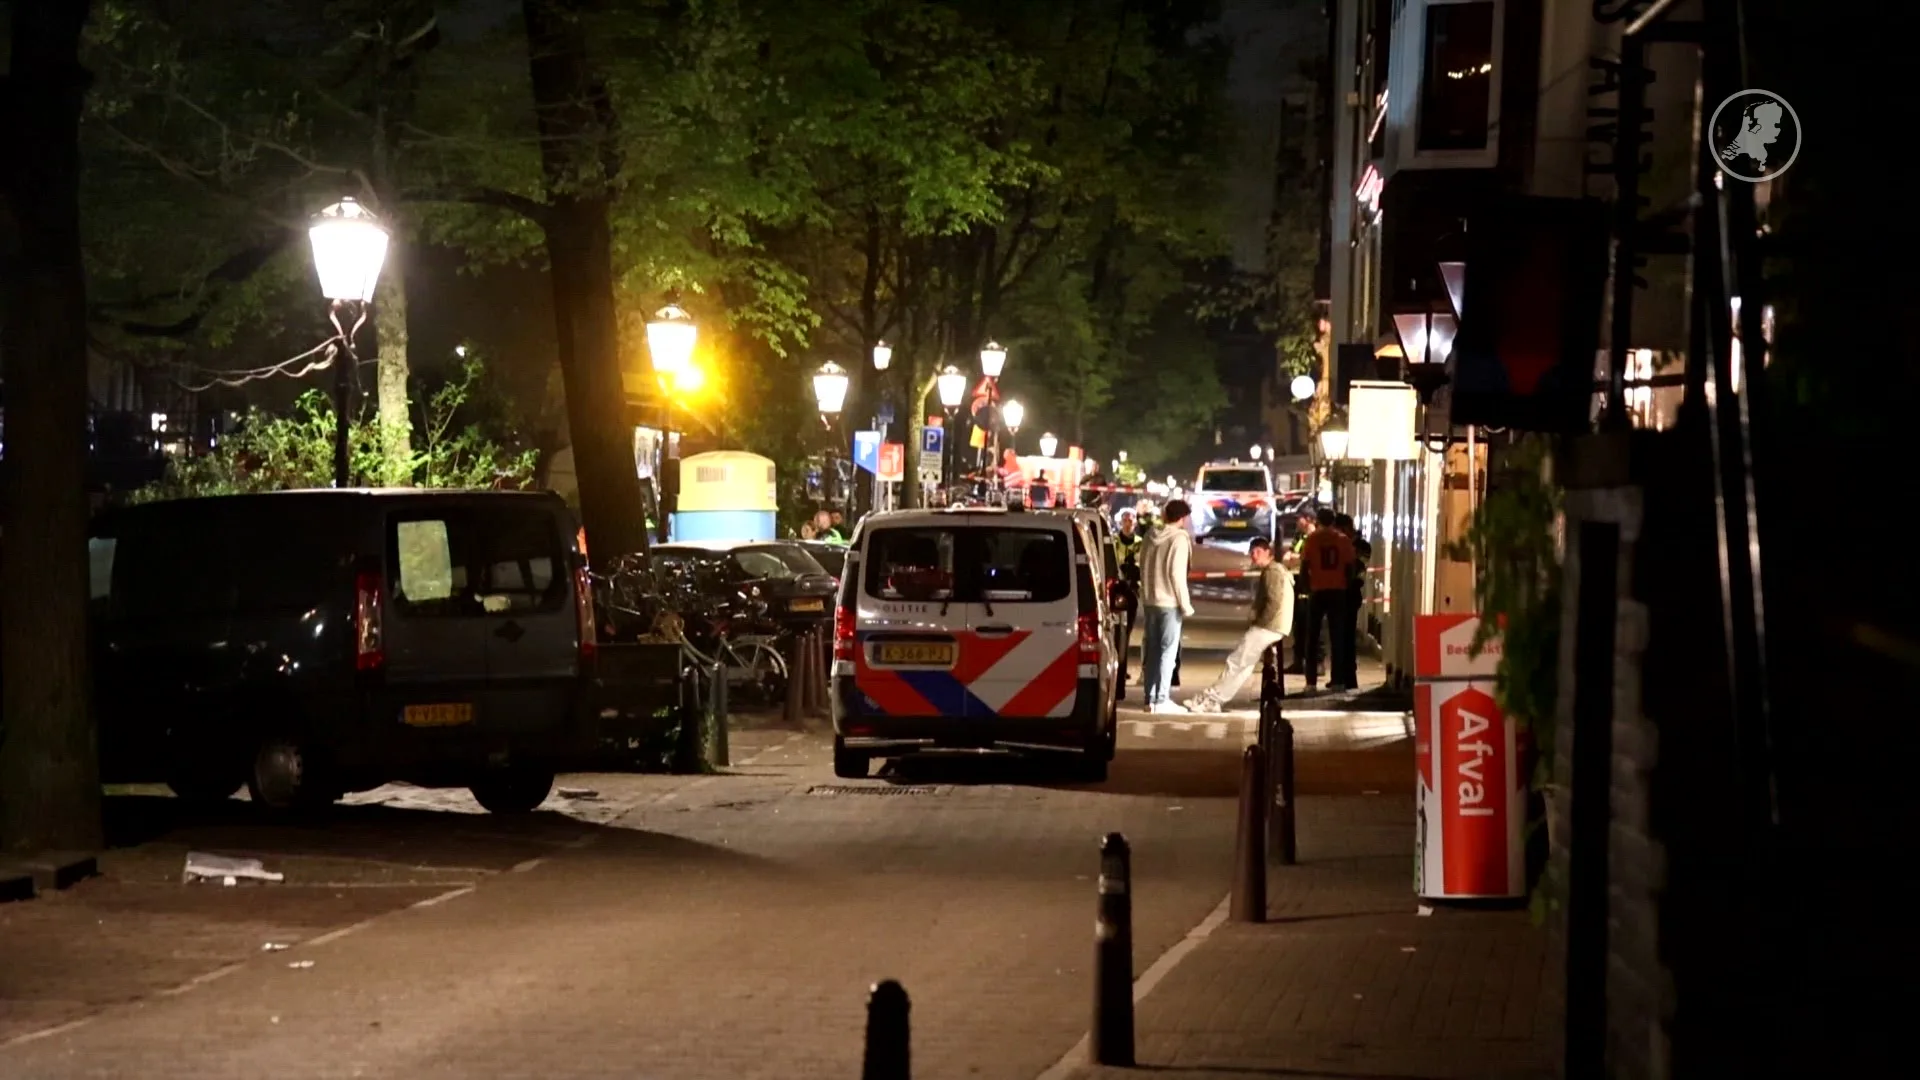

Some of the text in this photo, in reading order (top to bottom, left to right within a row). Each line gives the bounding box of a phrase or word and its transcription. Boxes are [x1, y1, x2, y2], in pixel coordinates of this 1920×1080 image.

[926, 431, 938, 450] P
[874, 603, 927, 613] OLITIE
[1446, 643, 1501, 655] Bednkt
[1457, 708, 1494, 816] Afval
